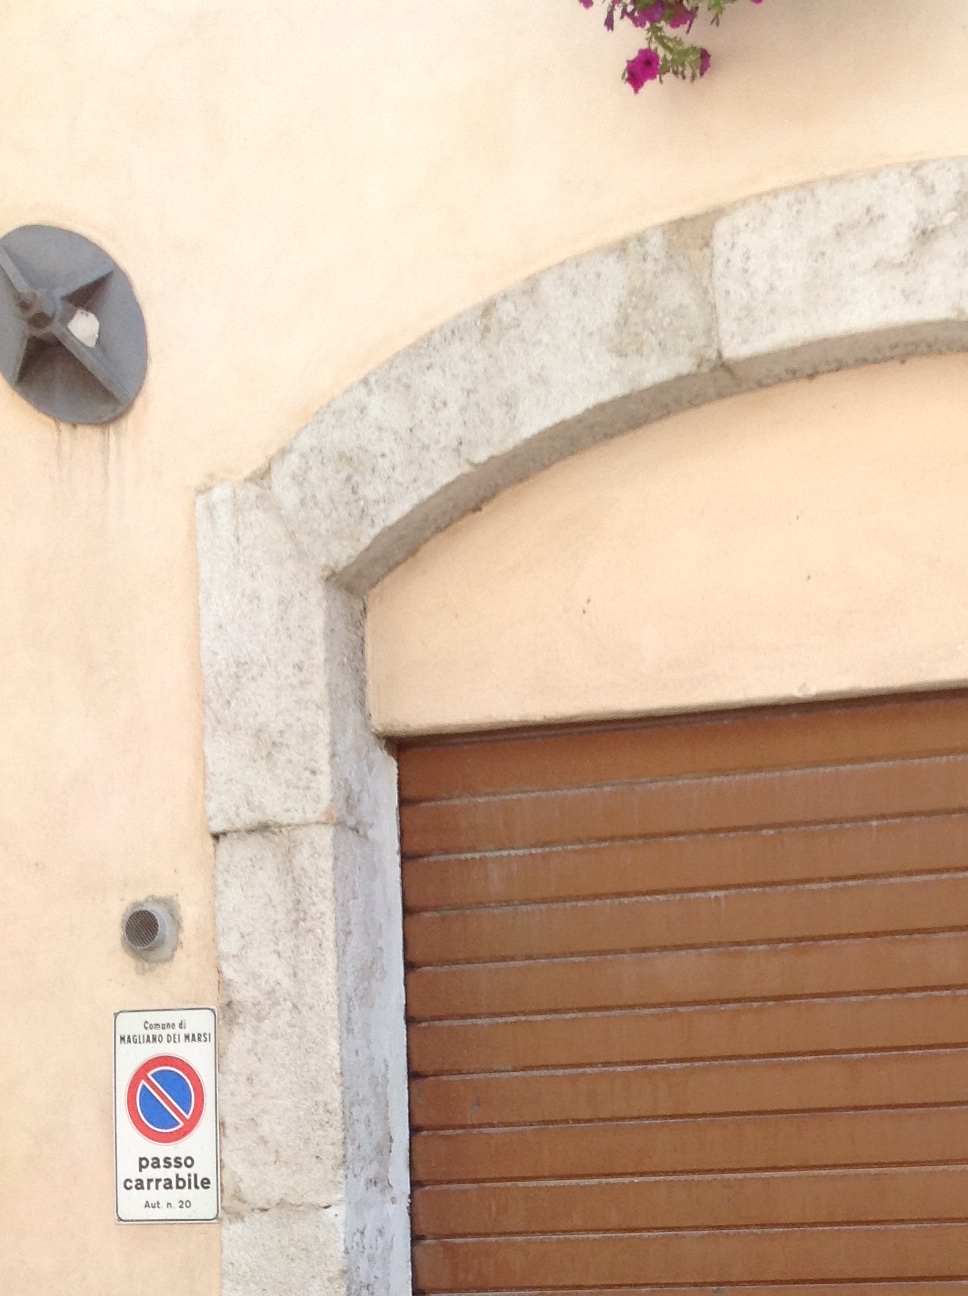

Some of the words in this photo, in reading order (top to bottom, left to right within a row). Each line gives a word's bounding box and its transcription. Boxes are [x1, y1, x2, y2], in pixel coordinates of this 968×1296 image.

[143, 1020, 176, 1031] Comune
[178, 1020, 187, 1030] di
[119, 1034, 164, 1045] MAGLIANO
[166, 1033, 181, 1044] DEI
[184, 1032, 212, 1043] MARSI
[138, 1155, 195, 1173] passo
[123, 1172, 212, 1191] carrabile
[178, 1199, 192, 1209] 20
